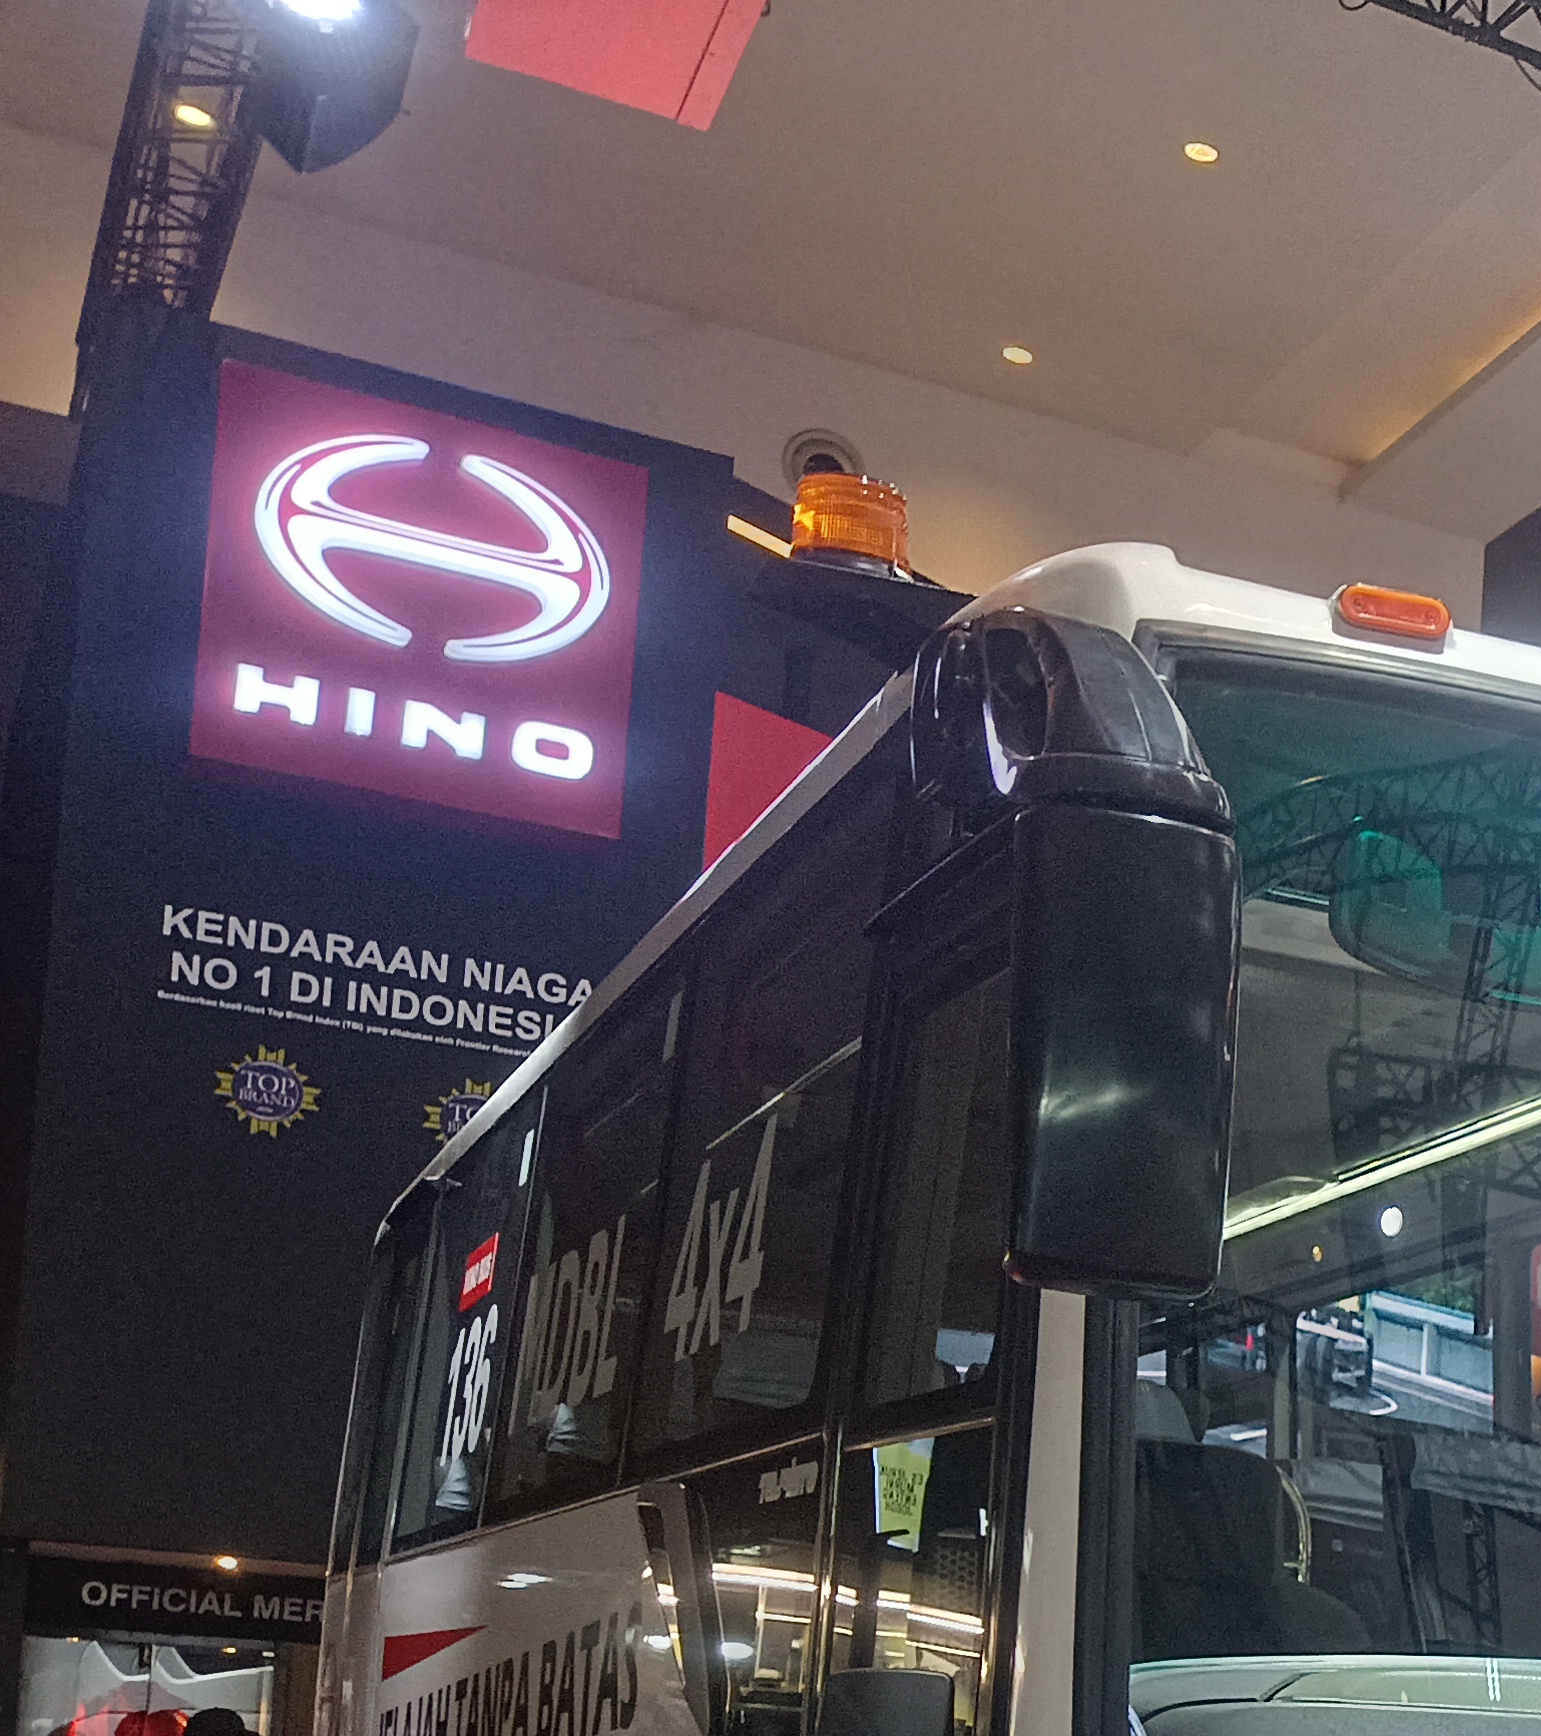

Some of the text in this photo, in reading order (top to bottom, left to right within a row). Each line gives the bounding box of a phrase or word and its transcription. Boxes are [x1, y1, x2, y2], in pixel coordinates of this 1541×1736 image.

[232, 662, 596, 781] HINO
[161, 904, 594, 1008] KENDARAAN NIAGA
[169, 950, 555, 1042] NO 1 DI INDONESI
[238, 1087, 296, 1109] BRAND
[239, 1068, 296, 1095] TOP
[440, 1303, 499, 1467] 136
[81, 1580, 326, 1622] OFFICIAL MER
